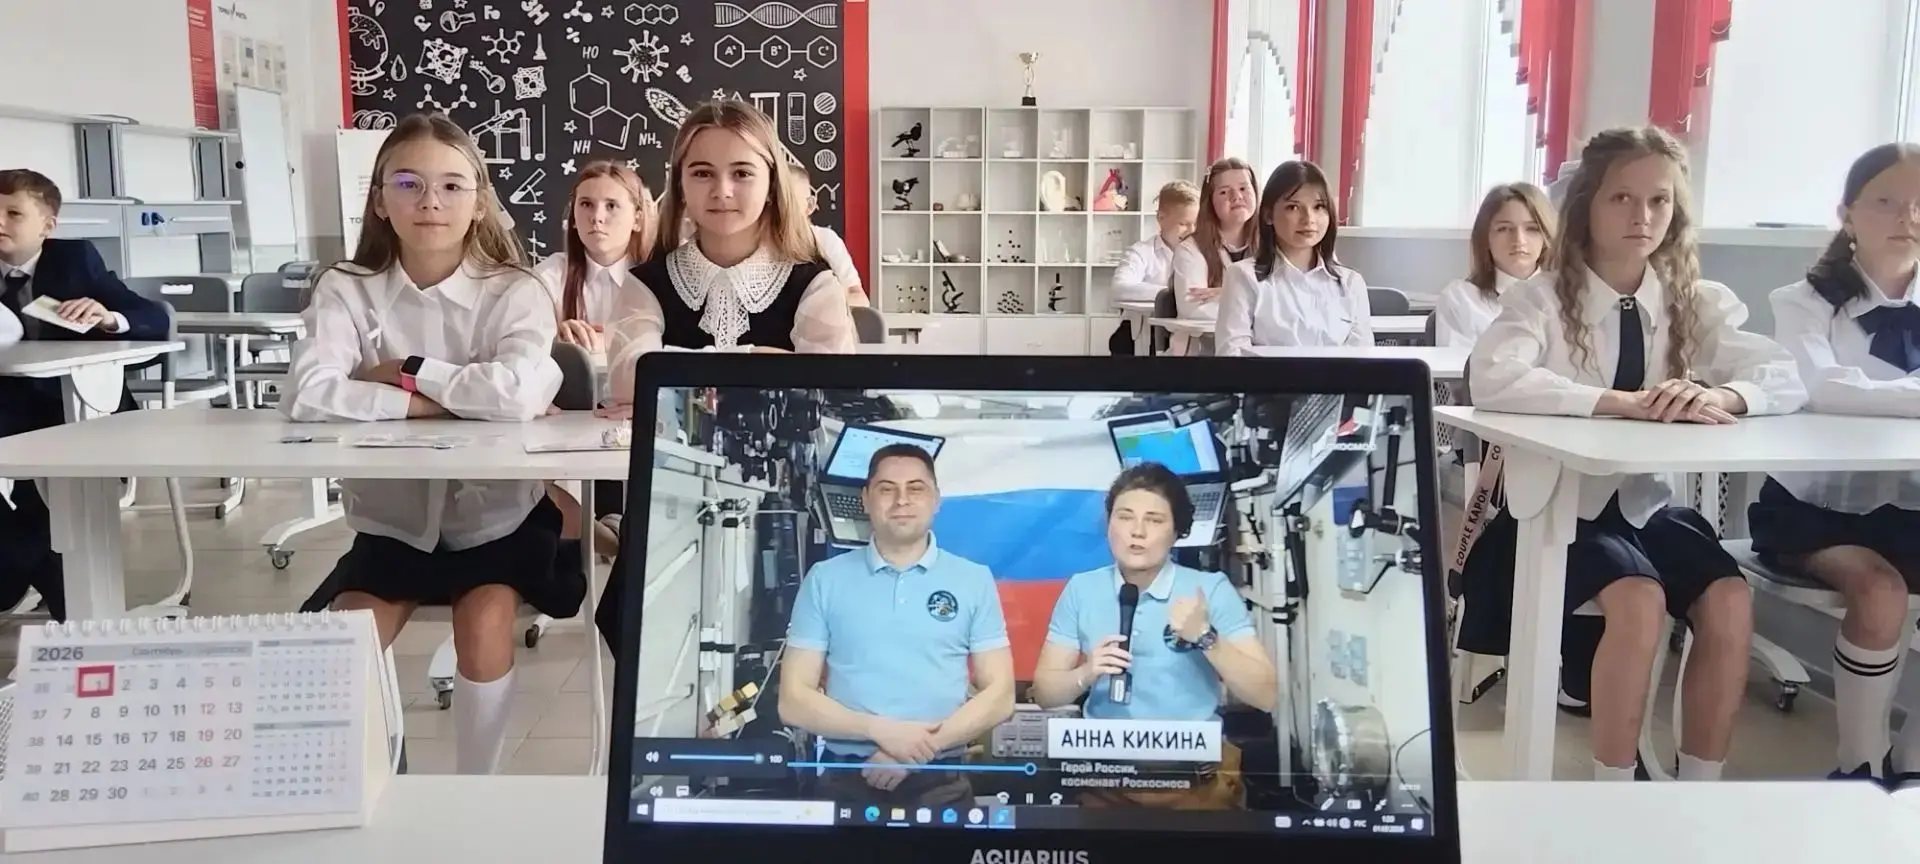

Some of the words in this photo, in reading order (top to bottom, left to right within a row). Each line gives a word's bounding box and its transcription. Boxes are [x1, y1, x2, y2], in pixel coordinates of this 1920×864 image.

[582, 46, 600, 59] HO
[573, 140, 592, 155] NH
[1456, 526, 1474, 567] COUPLE
[1467, 487, 1489, 525] KAPOK
[37, 647, 84, 662] 2026
[121, 679, 131, 691] 2
[149, 679, 159, 690] 3
[176, 677, 187, 688] 4
[204, 677, 214, 688] 5
[232, 676, 242, 687] 6
[63, 708, 72, 719] 7
[91, 707, 100, 719] 8
[119, 706, 129, 718] 9
[143, 705, 160, 717] 10
[172, 704, 186, 716] 11
[200, 703, 216, 715] 12
[228, 702, 243, 714] 13
[56, 735, 73, 747] 14
[85, 734, 102, 746] 15
[113, 733, 130, 744] 16
[142, 731, 158, 743] 17
[169, 730, 186, 742] 18
[198, 729, 214, 742] 19
[224, 728, 242, 740] 20
[1061, 729, 1116, 748] АННА
[1122, 730, 1207, 750] КИКИНА
[53, 762, 71, 774] 21
[81, 761, 101, 773] 22
[110, 760, 129, 772] 23
[138, 758, 157, 770] 24
[166, 757, 185, 770] 25
[194, 756, 213, 768] 26
[222, 755, 240, 767] 27
[1061, 762, 1093, 774] Герой
[1095, 762, 1138, 775] России,
[1061, 778, 1120, 788] космонавт
[1122, 778, 1191, 789] Роскосмоса
[50, 789, 70, 802] 28
[79, 788, 98, 801] 29
[107, 786, 128, 799] 30
[970, 848, 1090, 864] AQUARIUS
